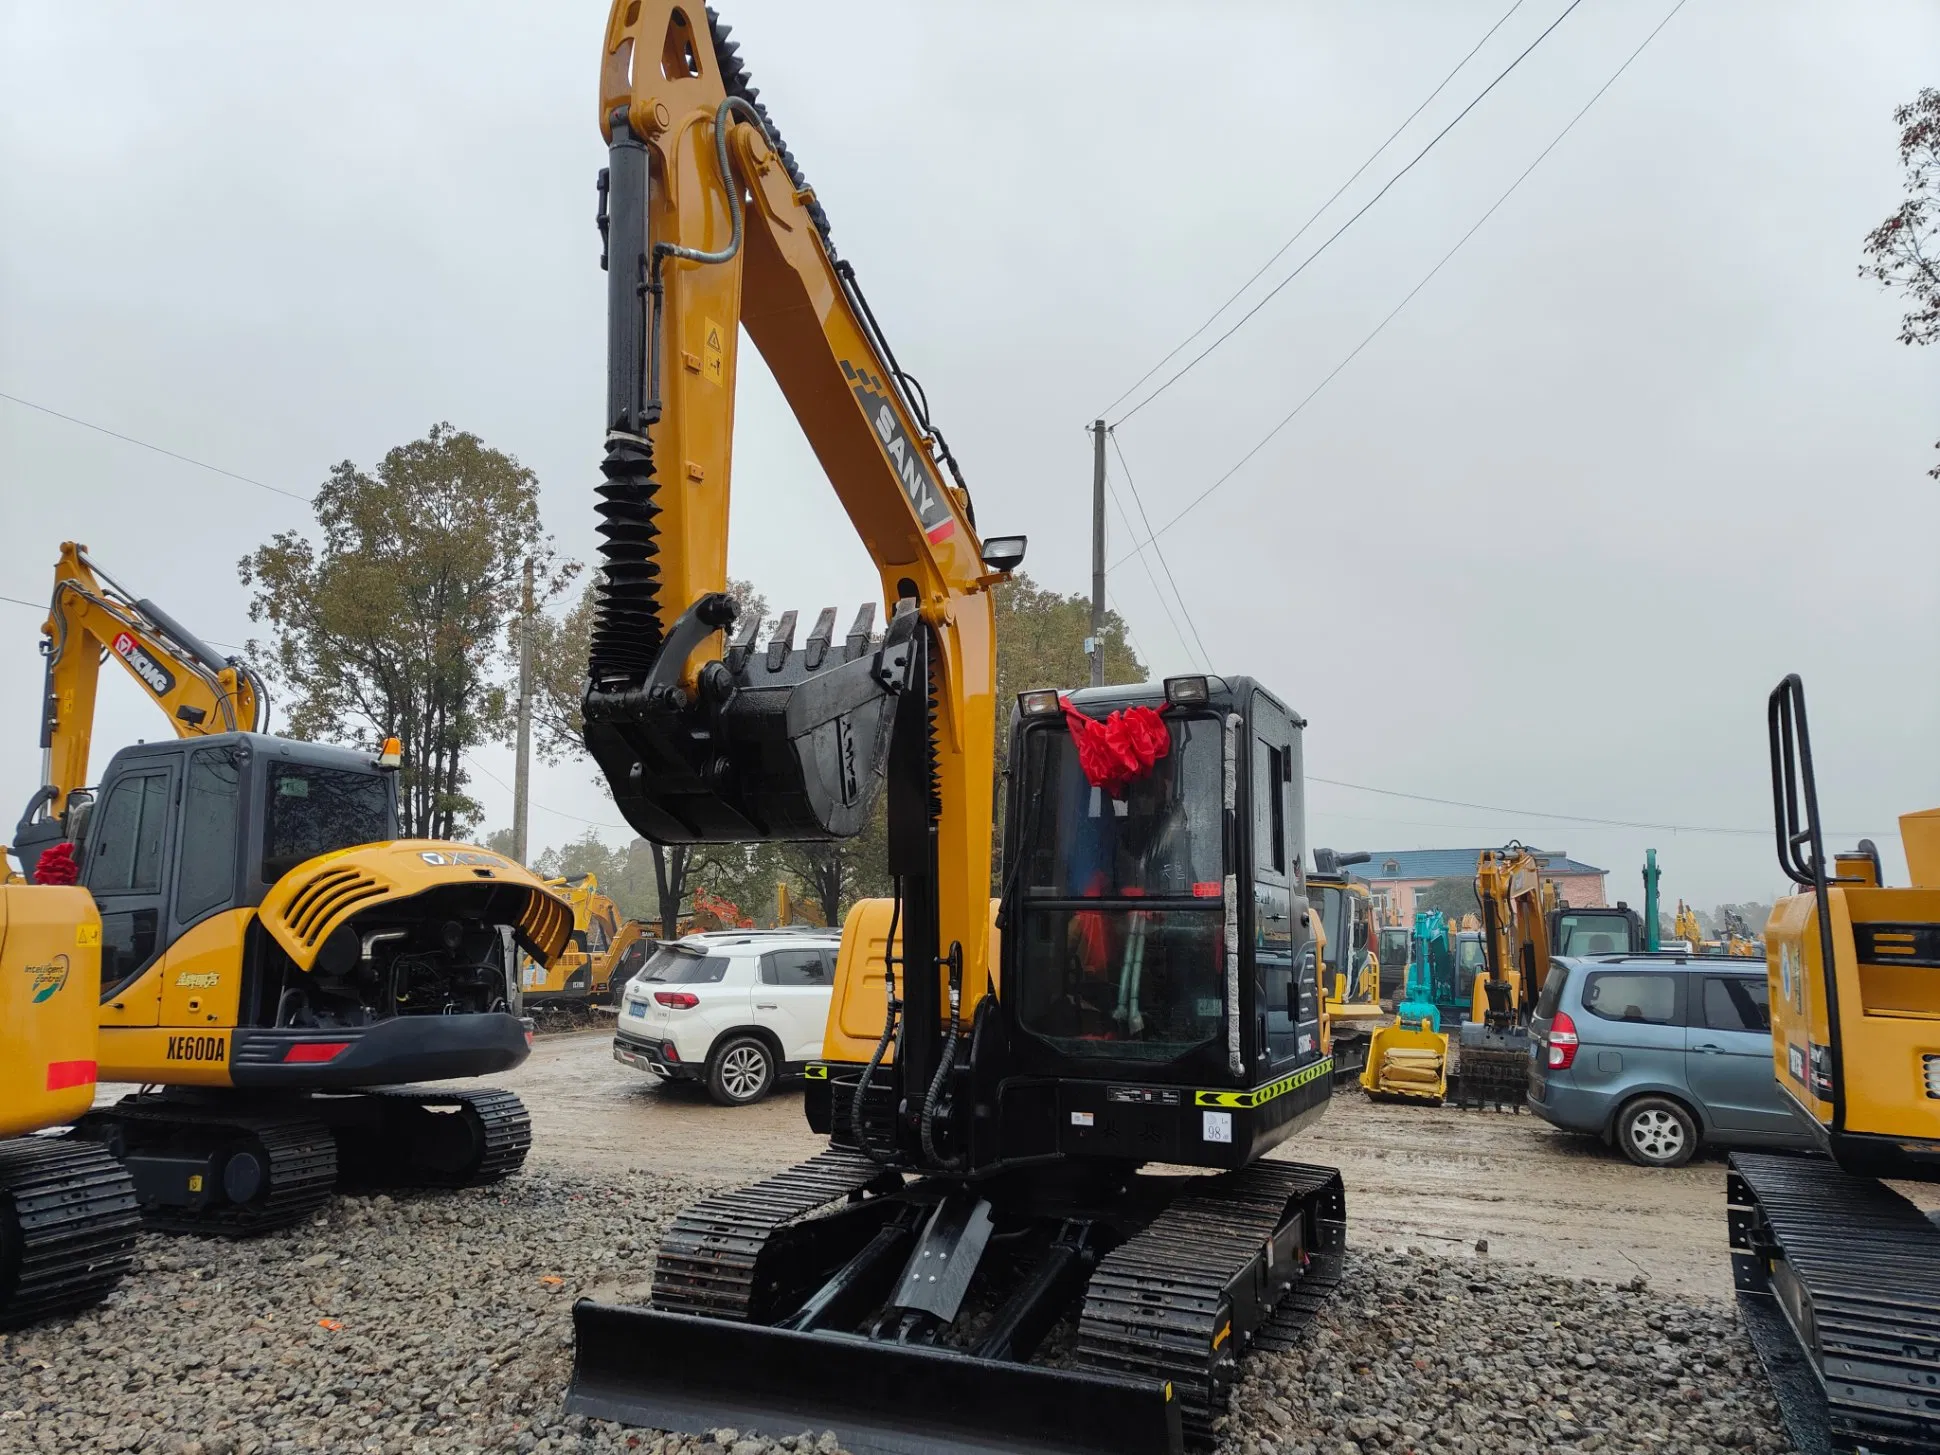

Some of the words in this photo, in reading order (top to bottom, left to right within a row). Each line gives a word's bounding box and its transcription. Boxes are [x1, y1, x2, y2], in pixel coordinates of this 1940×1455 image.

[875, 404, 935, 516] SANY
[125, 646, 168, 692] XCMG
[841, 720, 857, 798] SANY
[167, 1036, 225, 1061] XE60DA
[1208, 1125, 1221, 1140] 98
